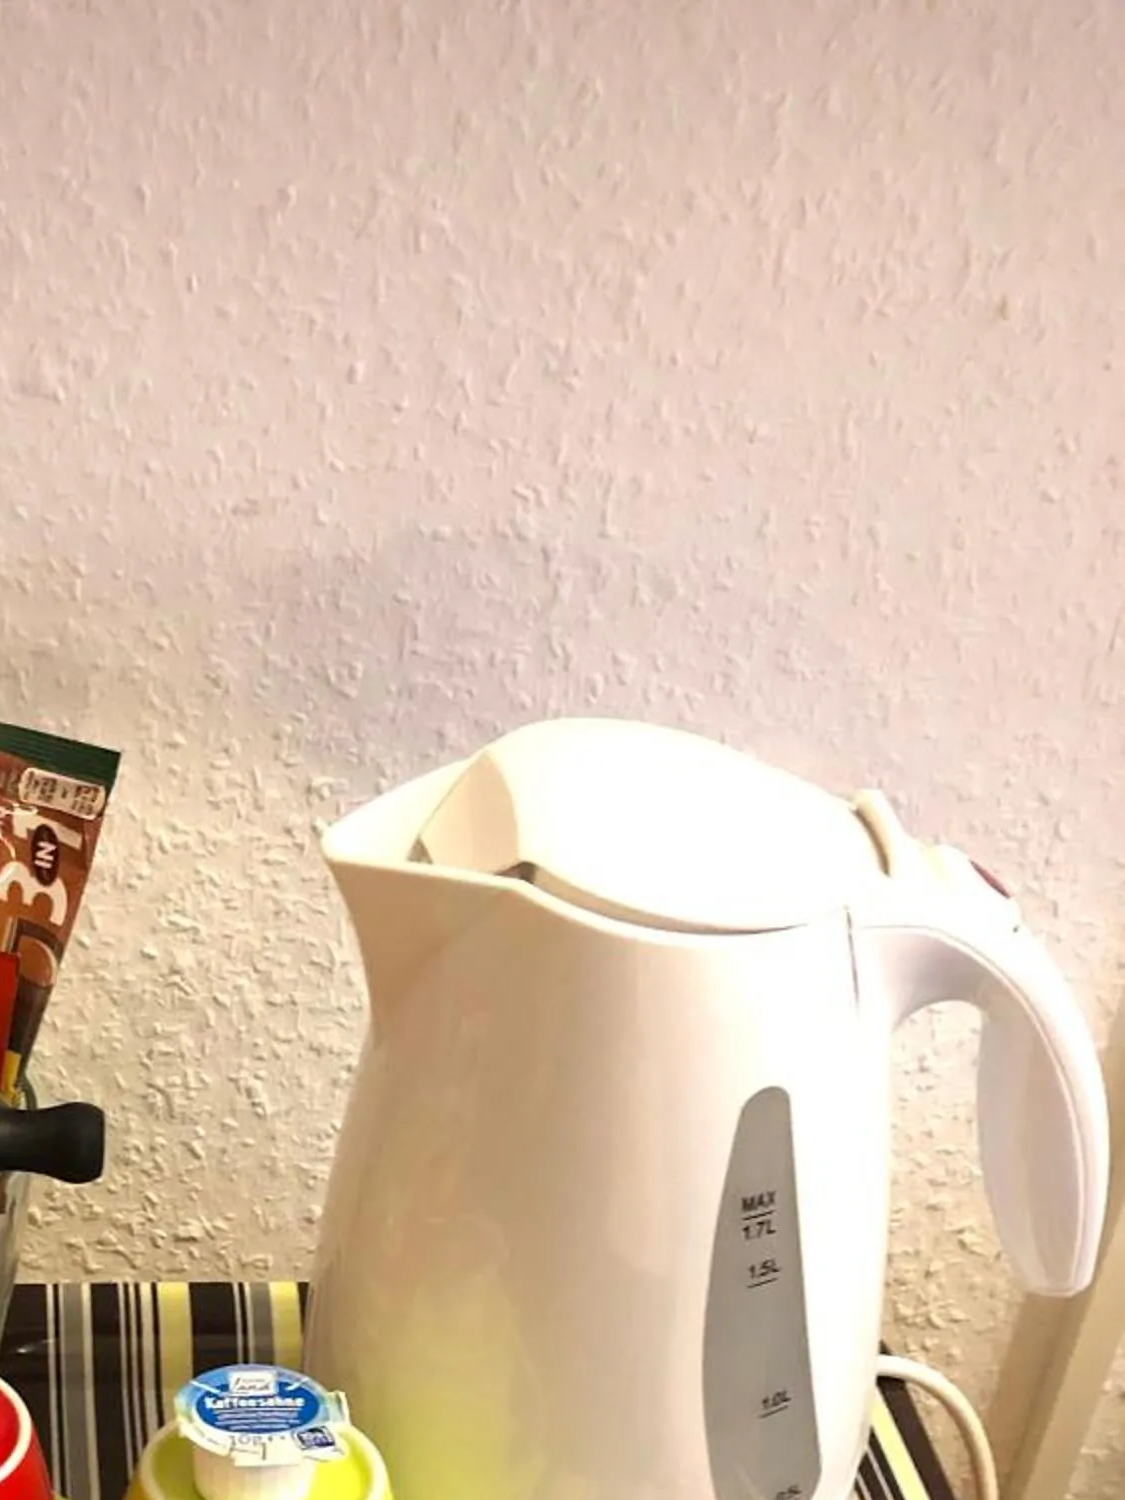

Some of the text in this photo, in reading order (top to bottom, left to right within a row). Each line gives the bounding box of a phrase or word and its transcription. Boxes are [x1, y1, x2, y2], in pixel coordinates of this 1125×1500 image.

[12, 803, 84, 850] 1
[34, 841, 57, 869] IN
[740, 1190, 777, 1212] MAX
[741, 1219, 777, 1241] 1.7L
[204, 1396, 306, 1410] Kaffeesahne
